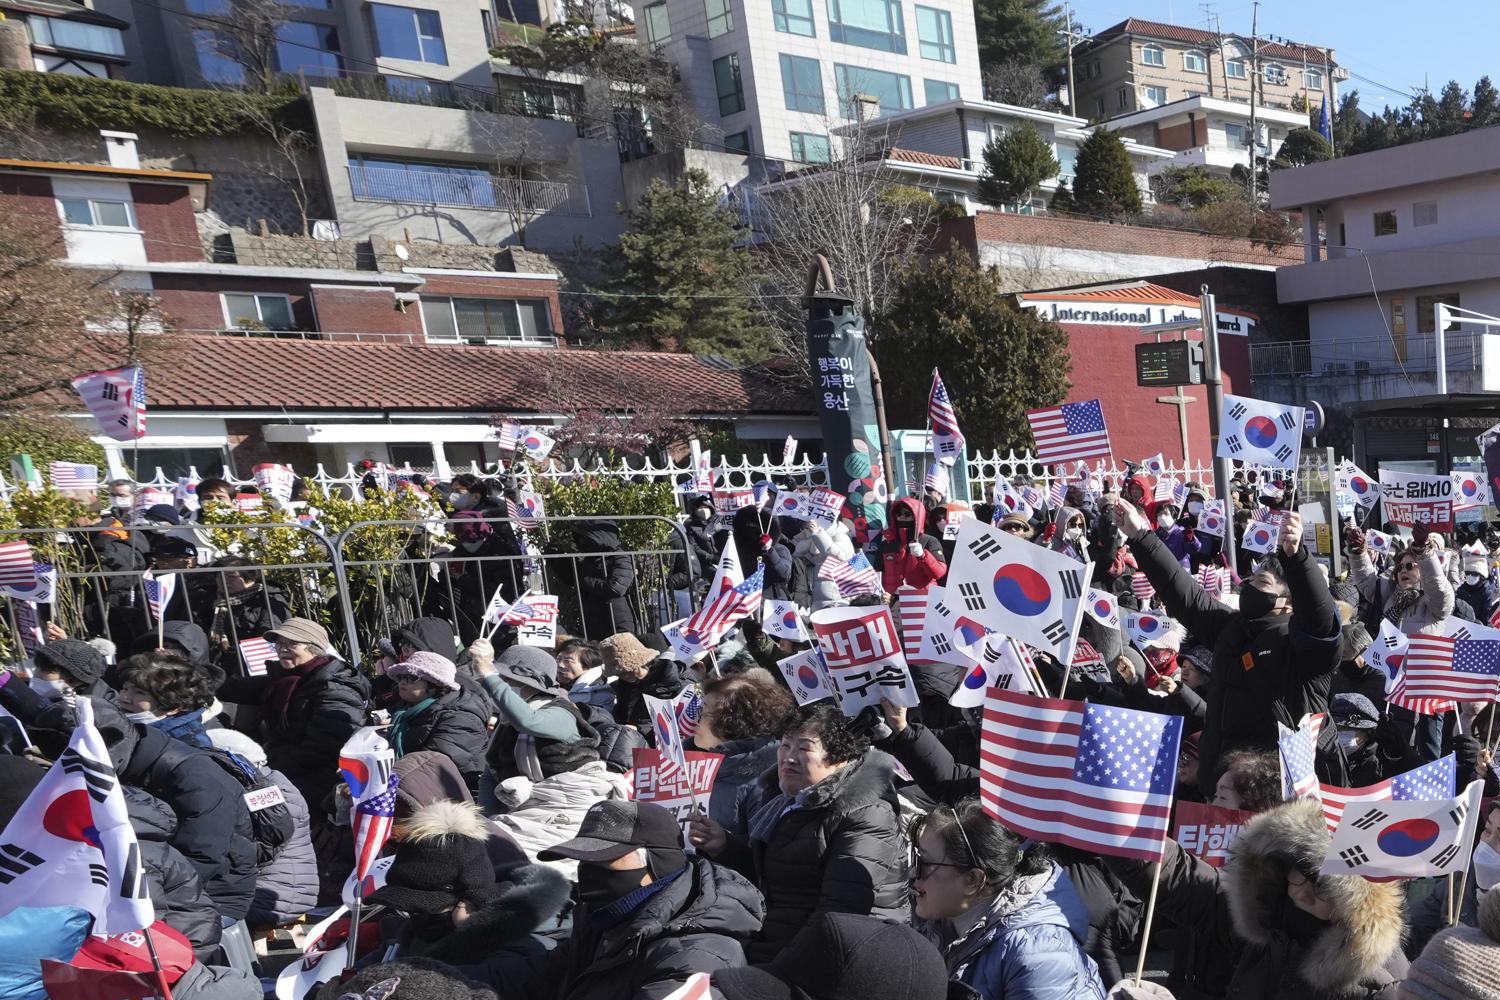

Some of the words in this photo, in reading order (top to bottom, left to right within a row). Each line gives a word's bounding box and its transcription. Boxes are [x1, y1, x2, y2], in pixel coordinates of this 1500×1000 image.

[1051, 303, 1151, 323] International
[818, 356, 853, 371] 행복이
[821, 374, 855, 388] 가득한
[824, 392, 850, 410] 용산
[1429, 433, 1440, 441] 148
[1407, 480, 1452, 499] 이재명
[521, 625, 553, 639] 구속
[846, 665, 906, 698] 구속
[249, 790, 280, 807] 부정선거
